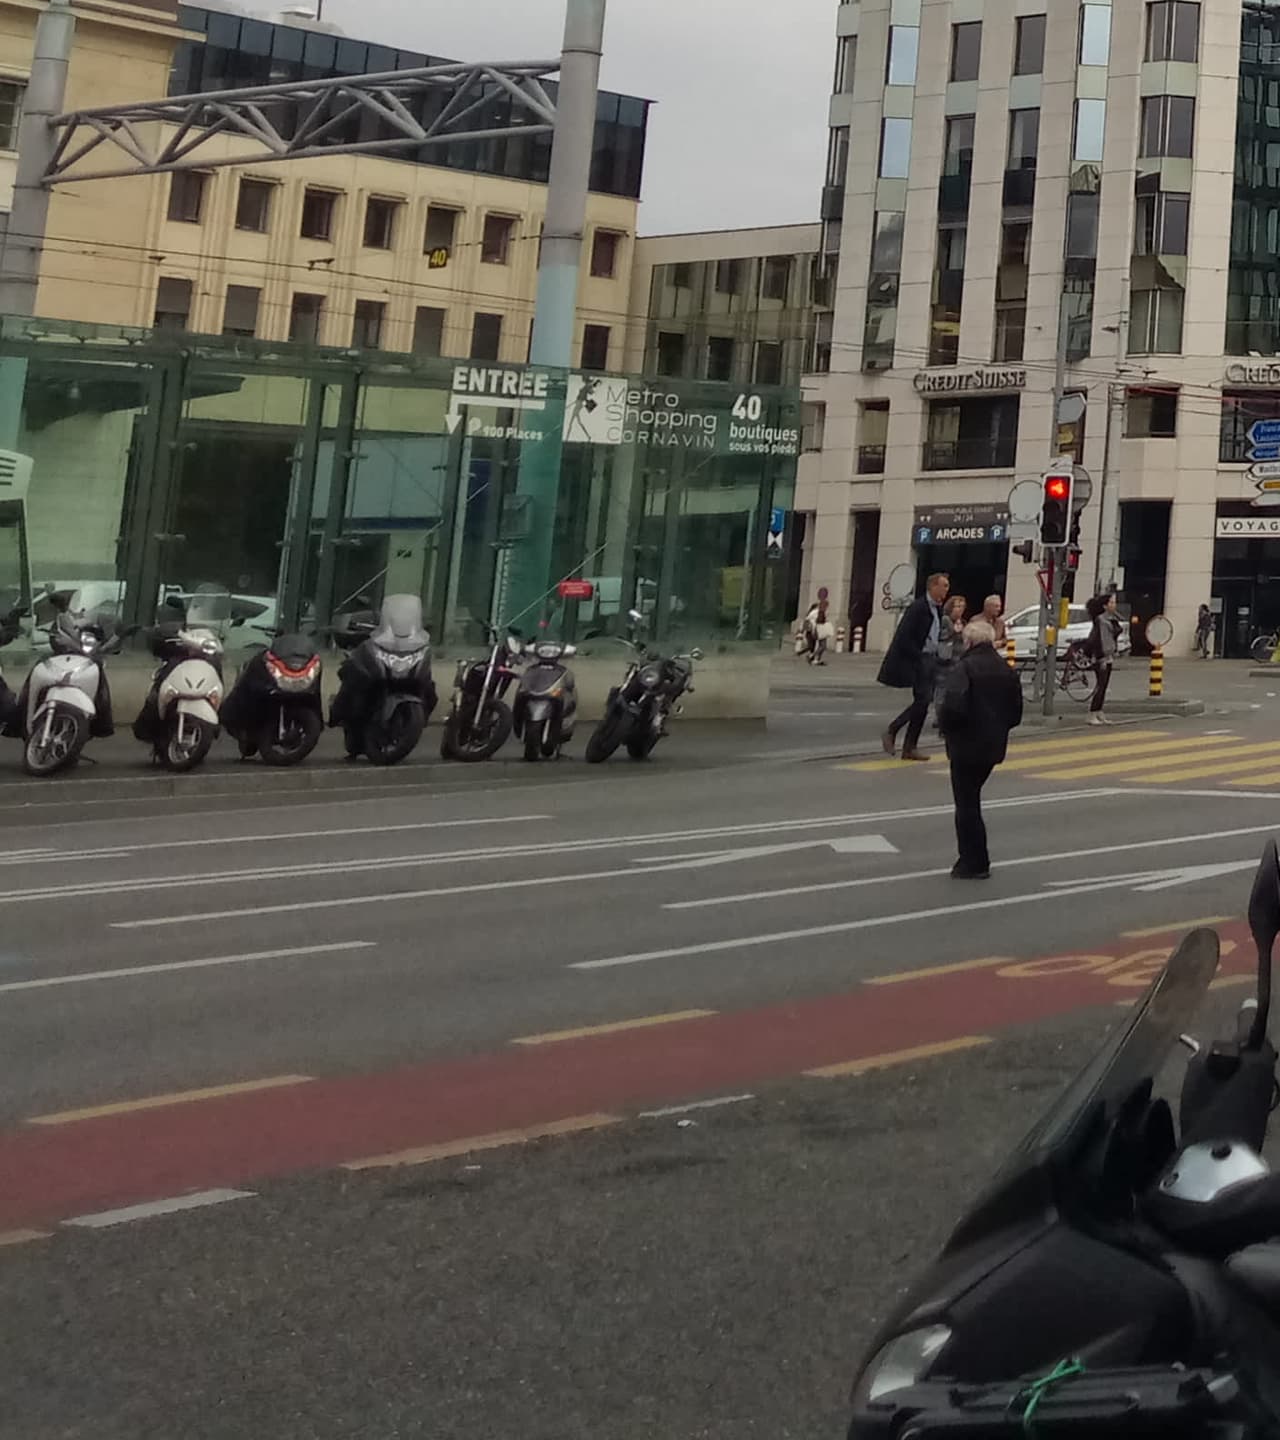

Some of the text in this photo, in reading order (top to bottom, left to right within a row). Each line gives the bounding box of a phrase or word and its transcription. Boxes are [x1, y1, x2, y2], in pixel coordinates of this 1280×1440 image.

[430, 249, 447, 266] 40
[912, 369, 1026, 392] CREDIT SUISSE
[605, 384, 680, 408] Metro
[729, 393, 762, 421] 40
[604, 404, 718, 435] Shopping
[505, 427, 543, 441] Places
[606, 426, 716, 450] CORNAVIN
[729, 421, 798, 442] boutiques
[729, 441, 797, 456] sous vos pieds
[936, 527, 985, 540] ARCADES
